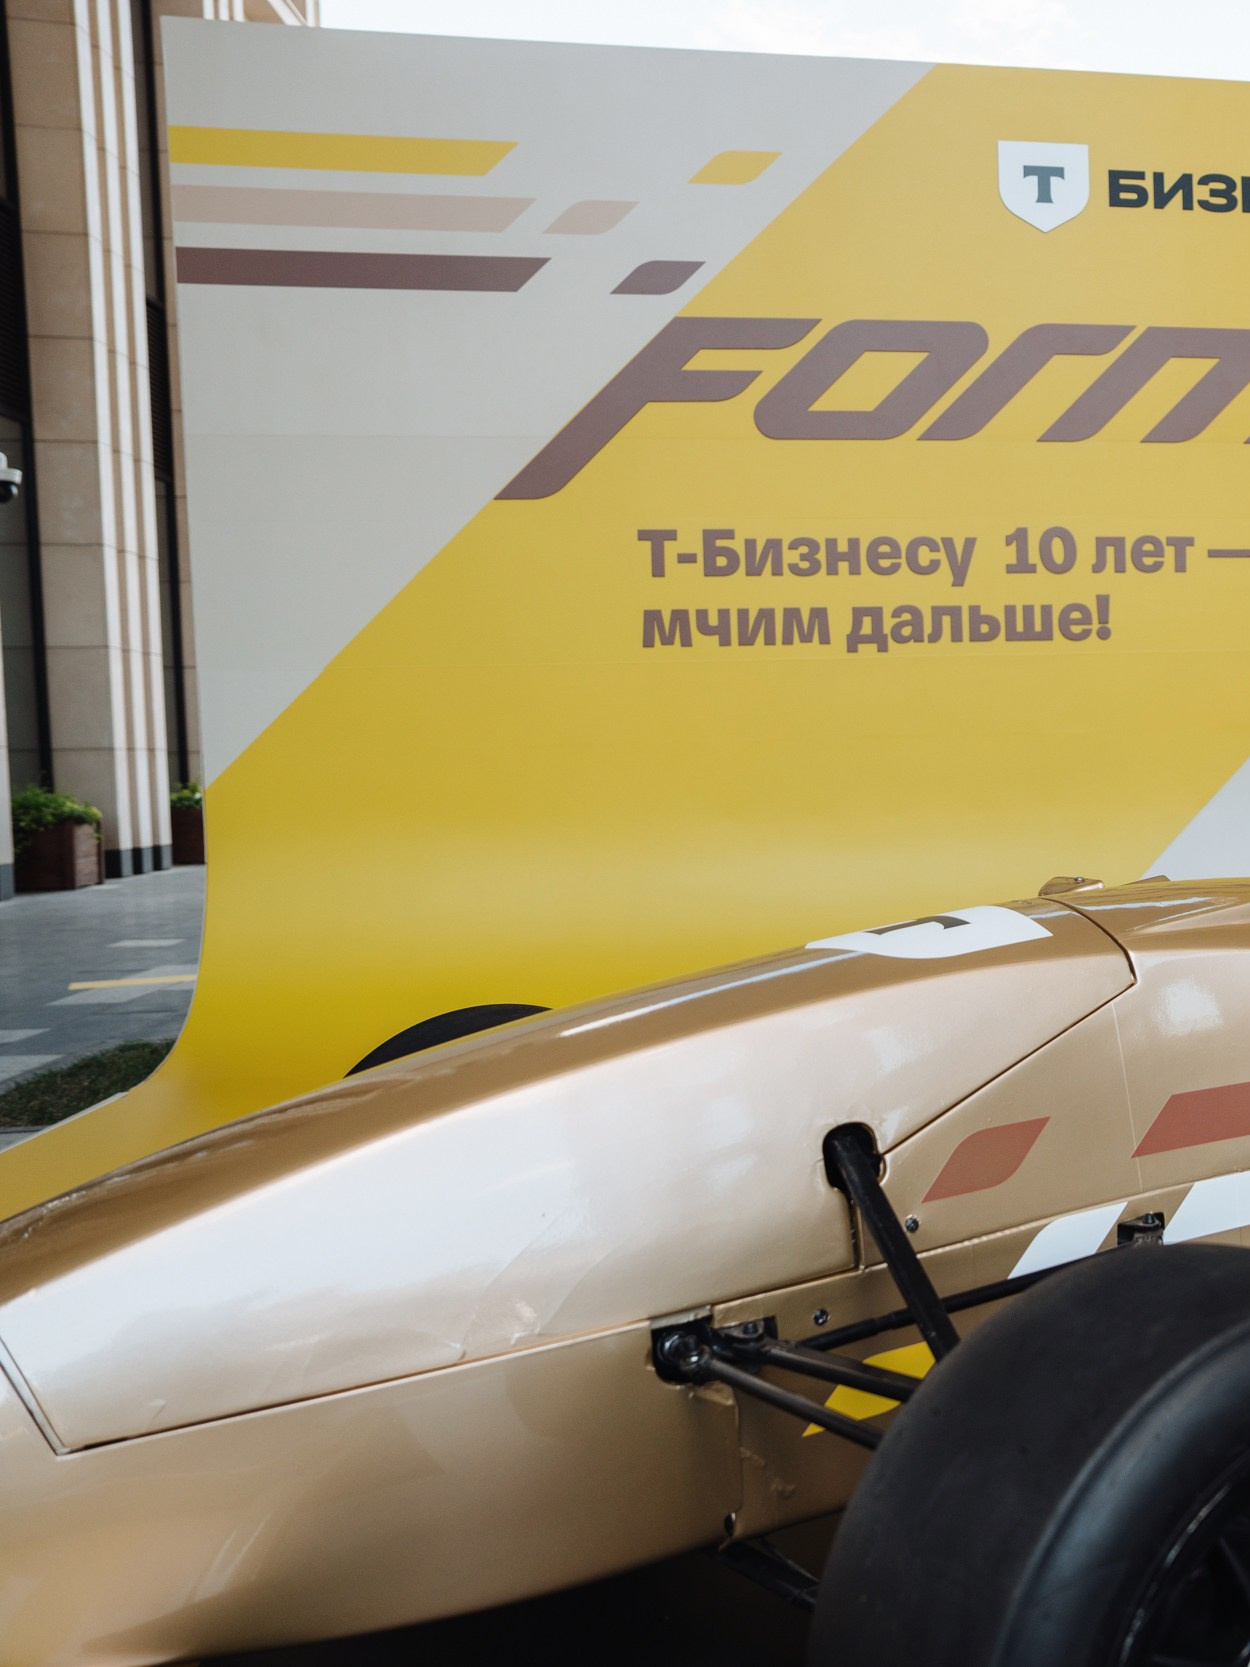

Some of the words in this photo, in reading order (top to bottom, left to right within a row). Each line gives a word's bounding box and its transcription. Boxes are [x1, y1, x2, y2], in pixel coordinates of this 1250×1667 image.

[1023, 165, 1065, 204] Т
[637, 529, 977, 587] Т-Бизнесу
[1005, 526, 1077, 574] 10
[1092, 534, 1195, 573] лет
[641, 605, 831, 648] мчим
[846, 594, 1112, 653] дальше!
